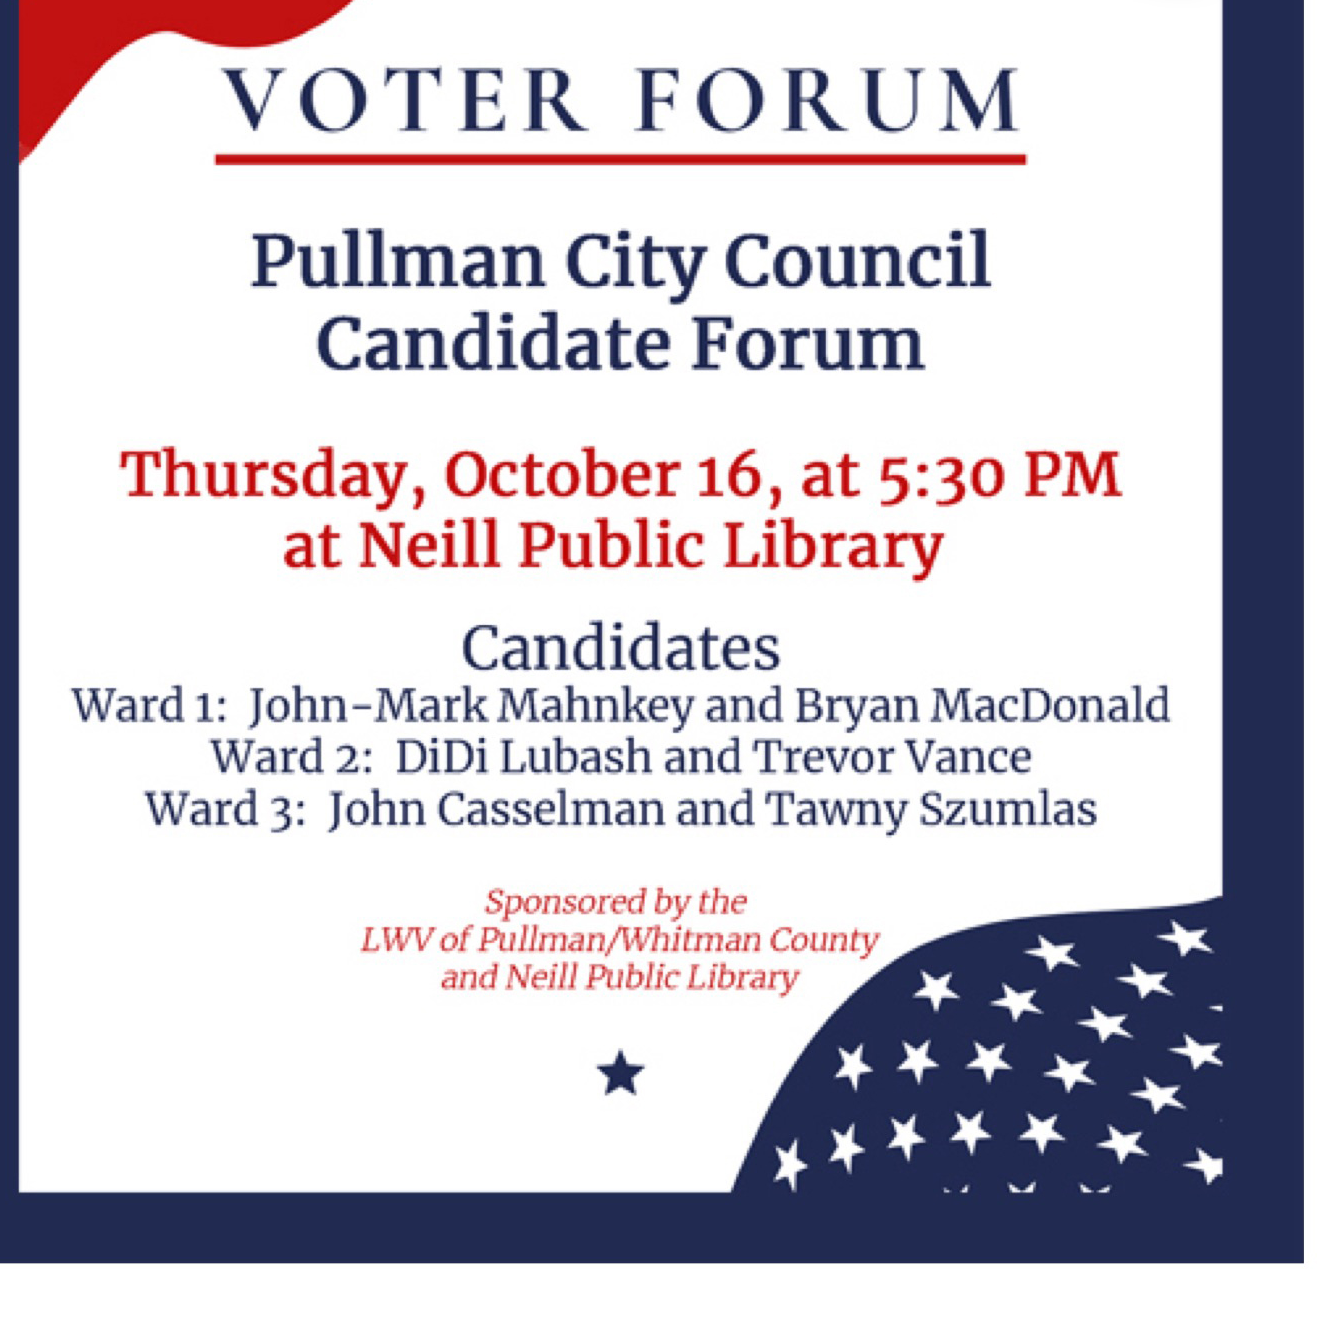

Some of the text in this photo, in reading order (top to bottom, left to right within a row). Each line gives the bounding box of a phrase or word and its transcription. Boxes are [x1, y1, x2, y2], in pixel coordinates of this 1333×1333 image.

[252, 228, 991, 304] Pullman City Council
[72, 685, 1170, 733] Ward 1: John-Mark Mahnkey and Bryan MacDonald
